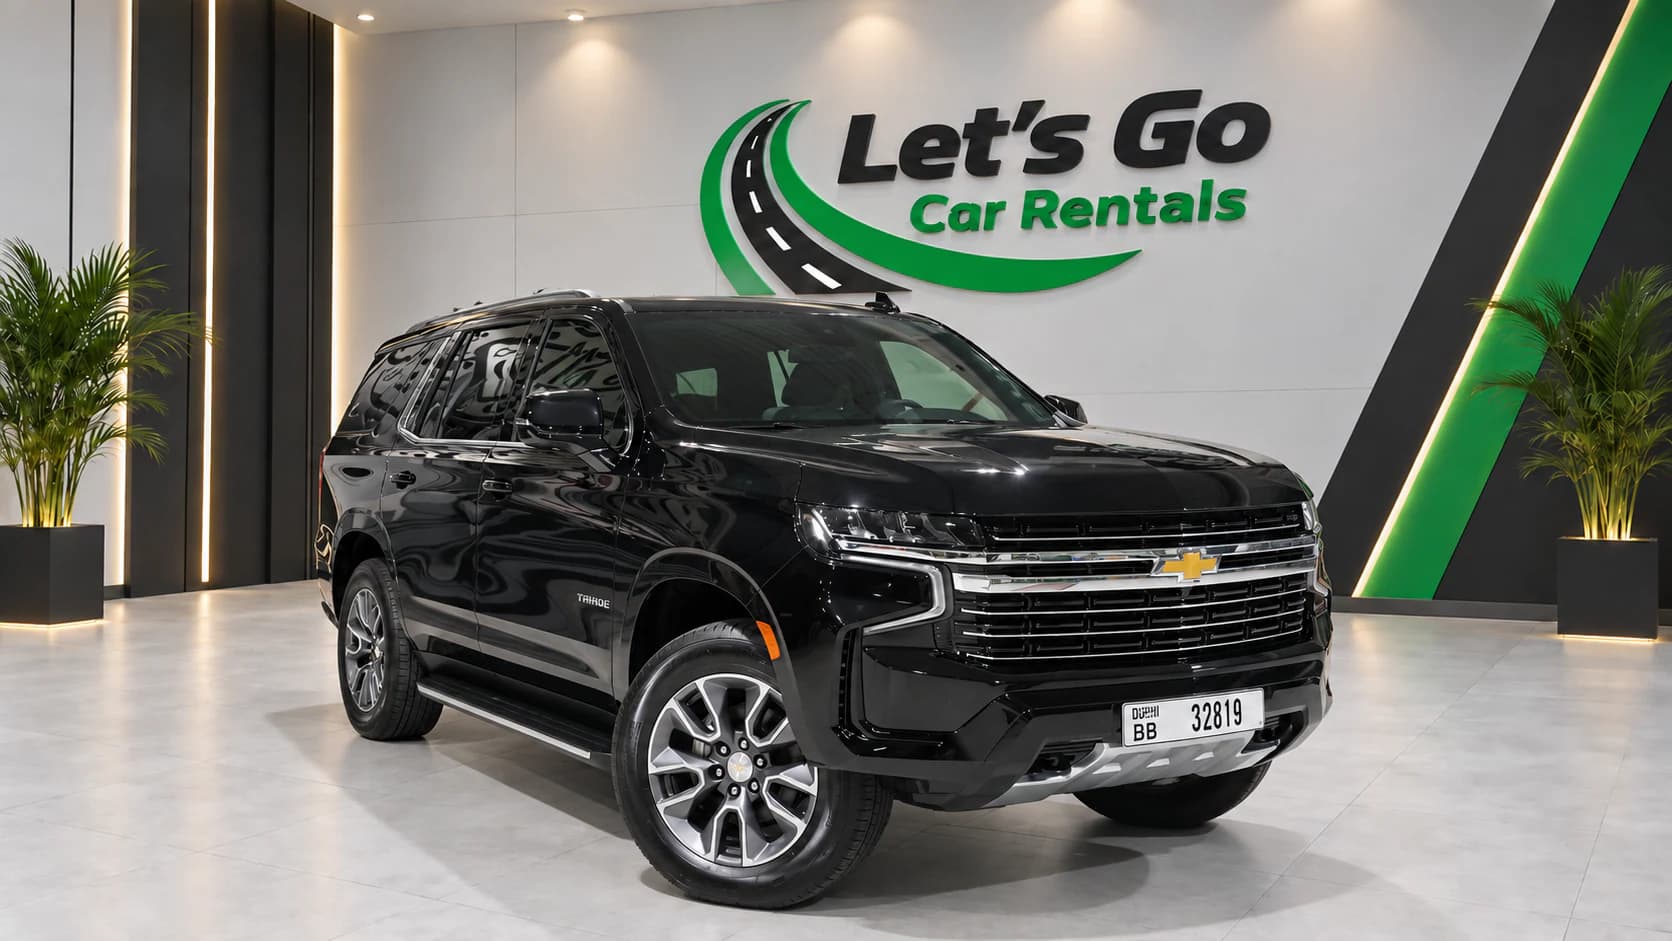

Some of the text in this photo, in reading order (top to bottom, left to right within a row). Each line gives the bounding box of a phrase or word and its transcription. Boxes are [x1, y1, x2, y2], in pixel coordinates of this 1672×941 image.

[838, 89, 1271, 183] Let's Go
[910, 179, 1247, 233] Car Rentals
[1133, 722, 1157, 742] BB
[1191, 698, 1242, 732] 32819
